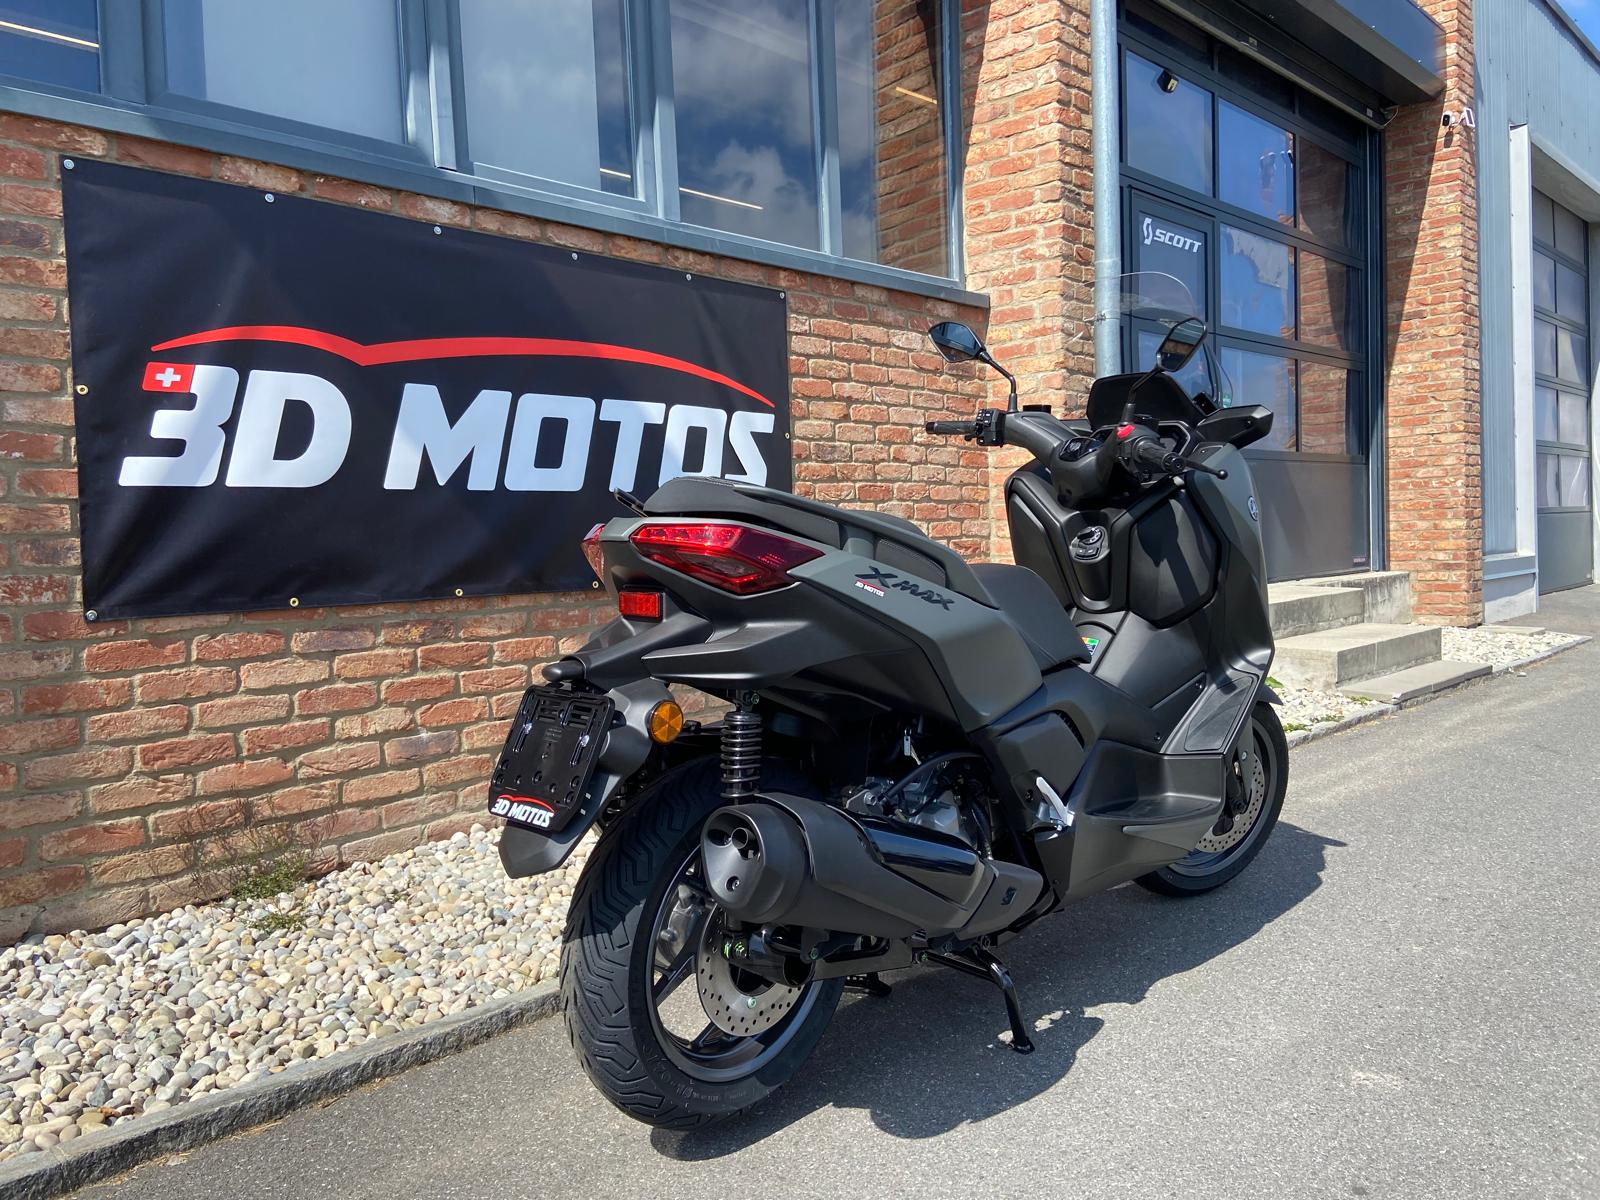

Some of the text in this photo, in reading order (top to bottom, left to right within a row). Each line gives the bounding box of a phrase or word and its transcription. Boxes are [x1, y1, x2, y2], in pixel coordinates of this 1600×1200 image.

[1153, 228, 1202, 252] SCOTT
[118, 362, 775, 492] 3D MOTOS
[490, 799, 554, 828] 3D MOTOS
